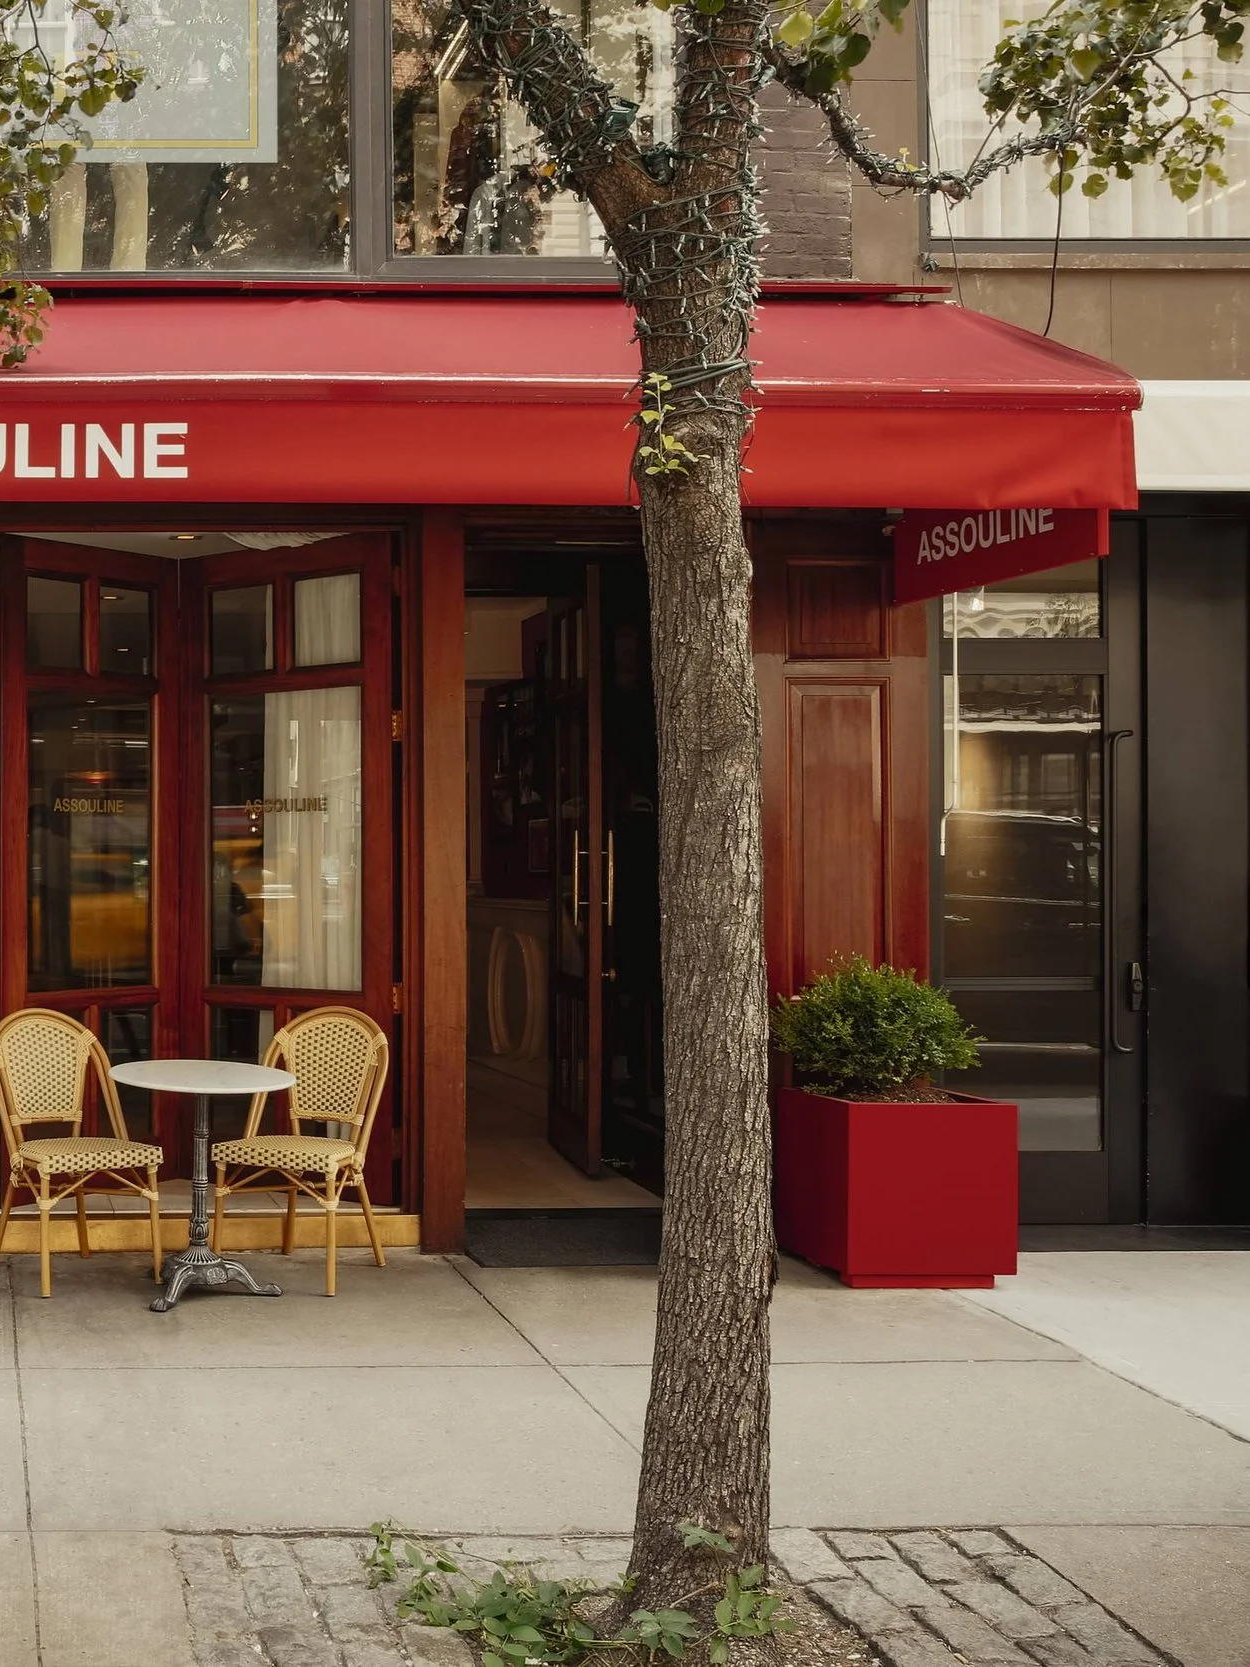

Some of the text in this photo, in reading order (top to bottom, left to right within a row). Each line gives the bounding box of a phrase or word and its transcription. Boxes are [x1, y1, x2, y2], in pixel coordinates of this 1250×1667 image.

[916, 508, 1055, 565] ASSOULINE
[53, 798, 124, 813] ASSOULINE
[244, 798, 328, 813] ASSOULINE
